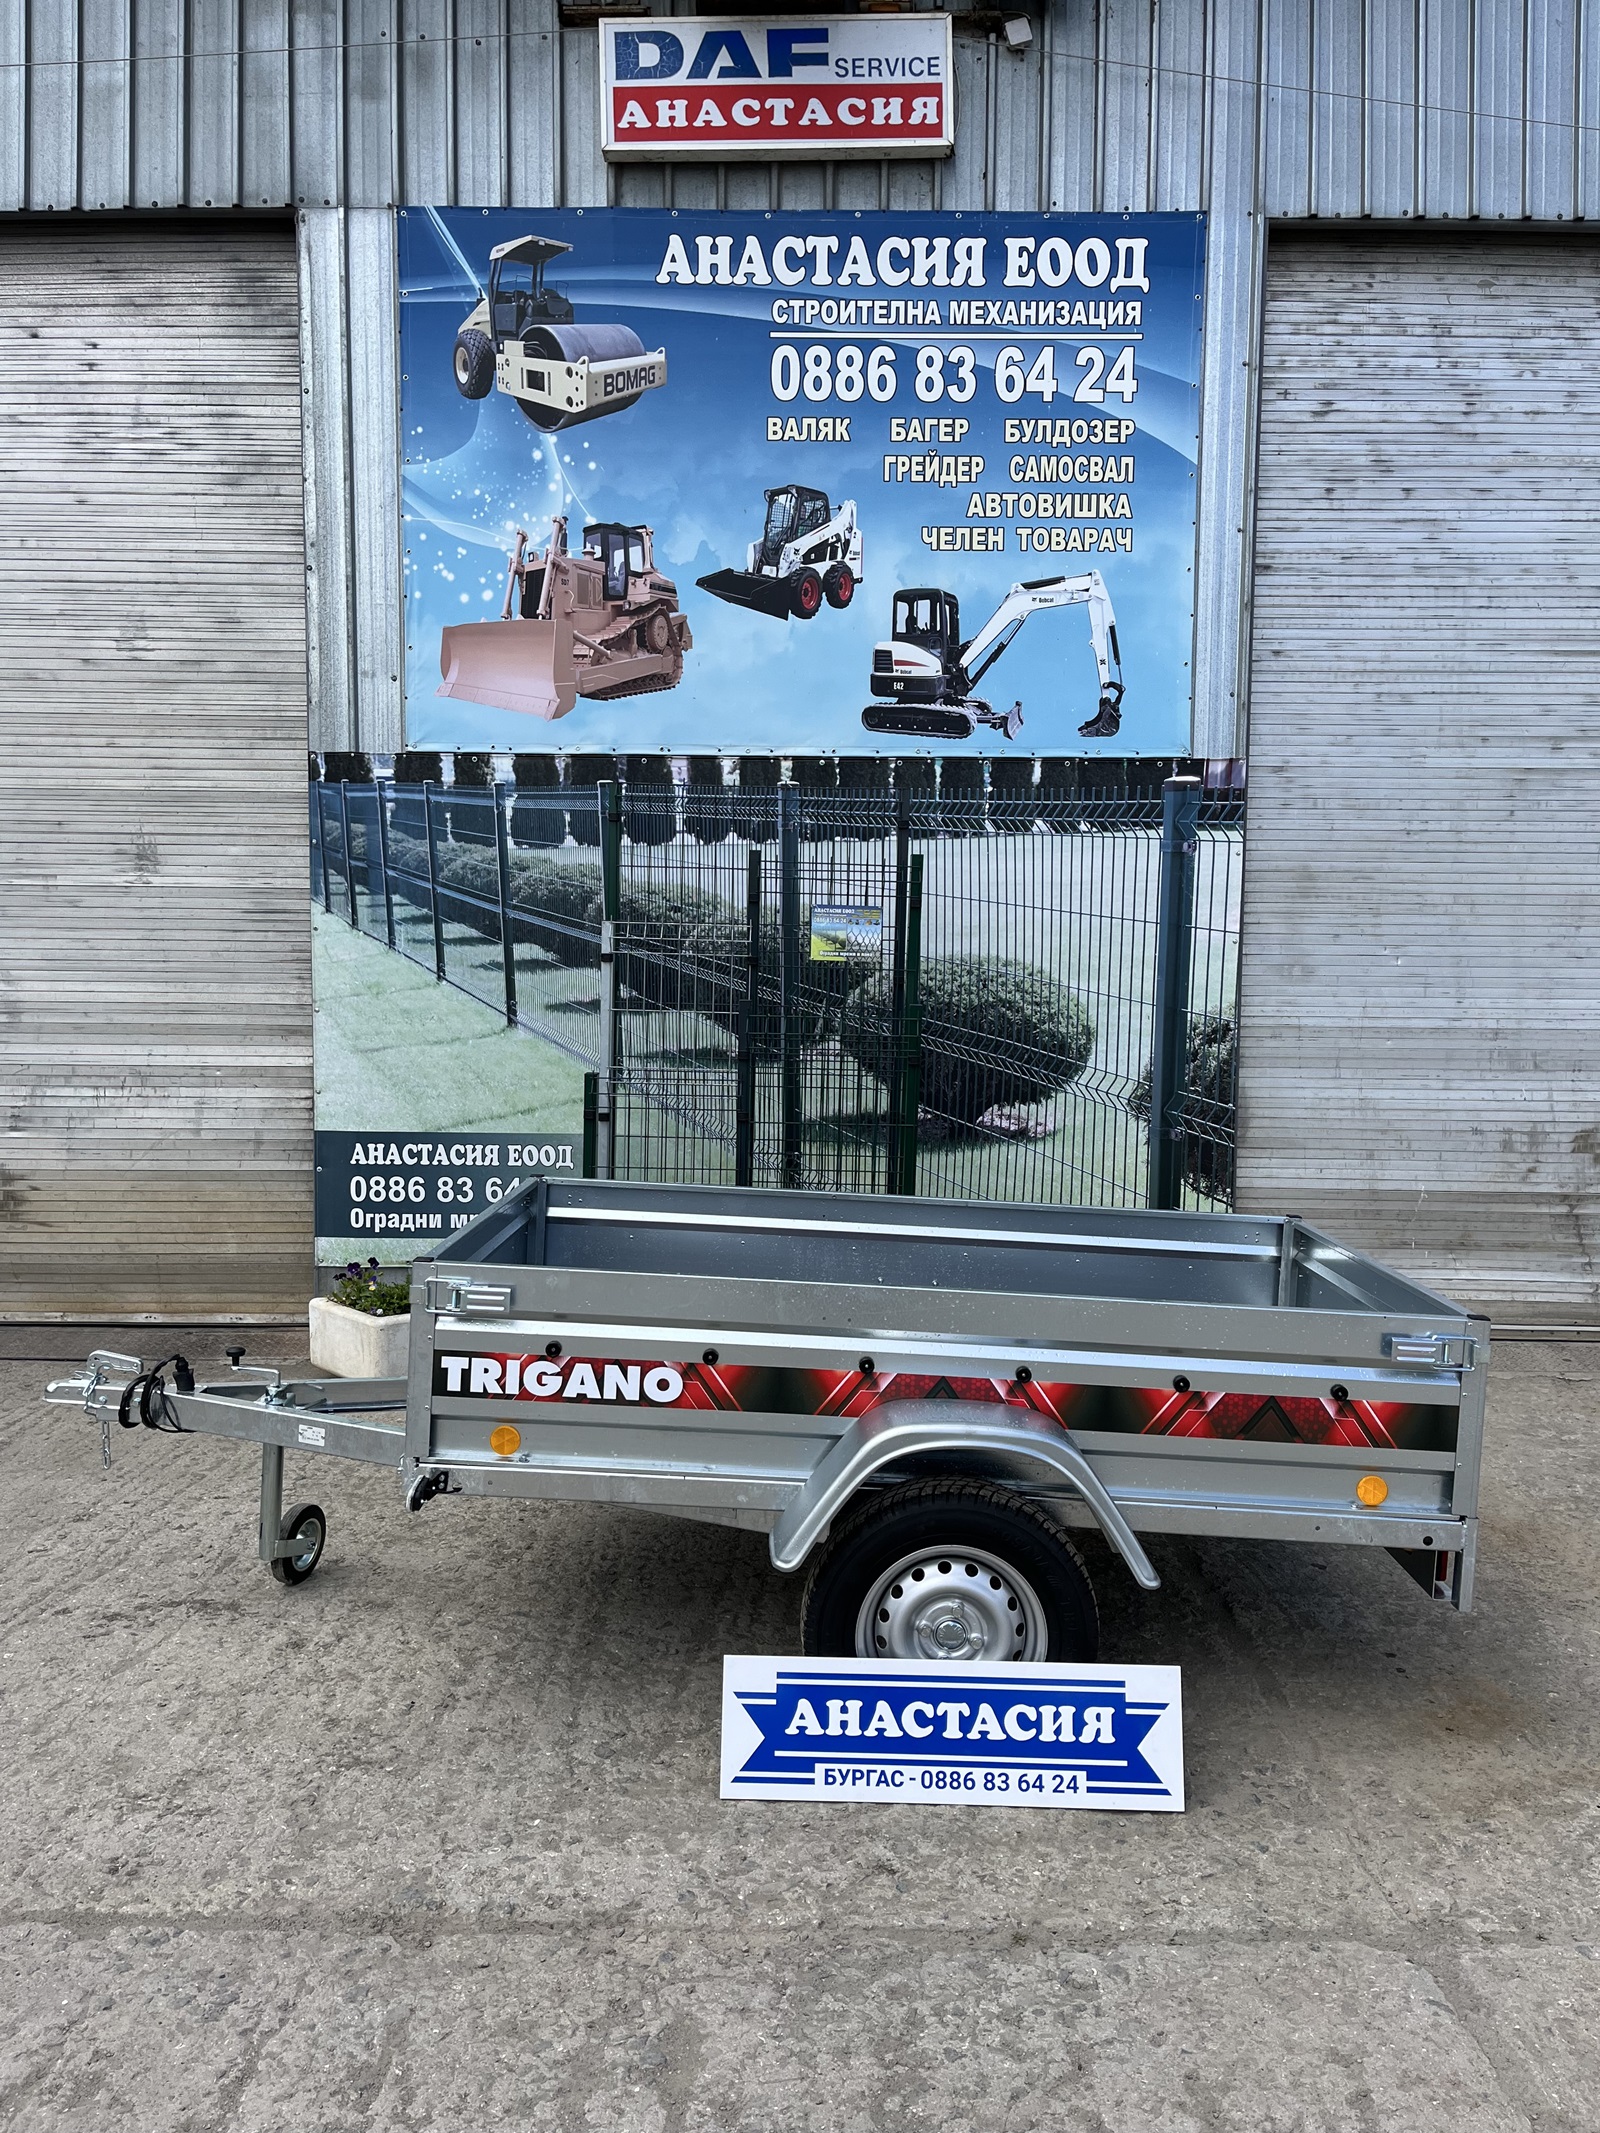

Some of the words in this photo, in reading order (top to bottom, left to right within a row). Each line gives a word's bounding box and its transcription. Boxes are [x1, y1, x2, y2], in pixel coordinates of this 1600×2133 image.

[614, 28, 830, 81] DAF
[834, 56, 941, 78] SERVICE
[617, 96, 941, 129] АНАСТАСИЯ
[655, 234, 987, 288] АНАСТАСИЯ
[1003, 237, 1150, 294] ЕООД
[772, 299, 942, 325] СТРОИТЕЛНА
[949, 300, 1142, 330] МЕХАНИЗАЦИЯ
[603, 365, 656, 397] BOMAG
[770, 345, 898, 402] 0886
[915, 346, 977, 403] 83
[994, 346, 1058, 403] 64
[1074, 346, 1138, 404] 24
[767, 417, 851, 442] ВАЛЯК
[890, 418, 970, 443] БАГЕР
[1004, 419, 1136, 447] БУЛДОЗЕР
[883, 450, 985, 487] ГРЕЙДЕР
[1009, 455, 1135, 483] САМОСВАЛ
[966, 493, 1132, 519] АВТОВИШКА
[921, 527, 1005, 552] ЧЕЛЕН
[1016, 527, 1134, 552] ТОВАРАЧ
[893, 681, 905, 691] E42
[350, 1142, 500, 1167] АНАСТАСИЯ
[507, 1144, 574, 1169] ЕООД
[350, 1175, 426, 1203] 0886
[437, 1176, 474, 1204] 83
[350, 1207, 442, 1233] Оградни
[440, 1355, 684, 1403] TRIGANO
[784, 1697, 1117, 1745] АНАСТАСИЯ
[824, 1767, 905, 1789] БУРГАС
[920, 1771, 976, 1792] 0886
[983, 1772, 1010, 1793] 83
[1017, 1773, 1046, 1794] 64
[1051, 1774, 1080, 1795] 24
